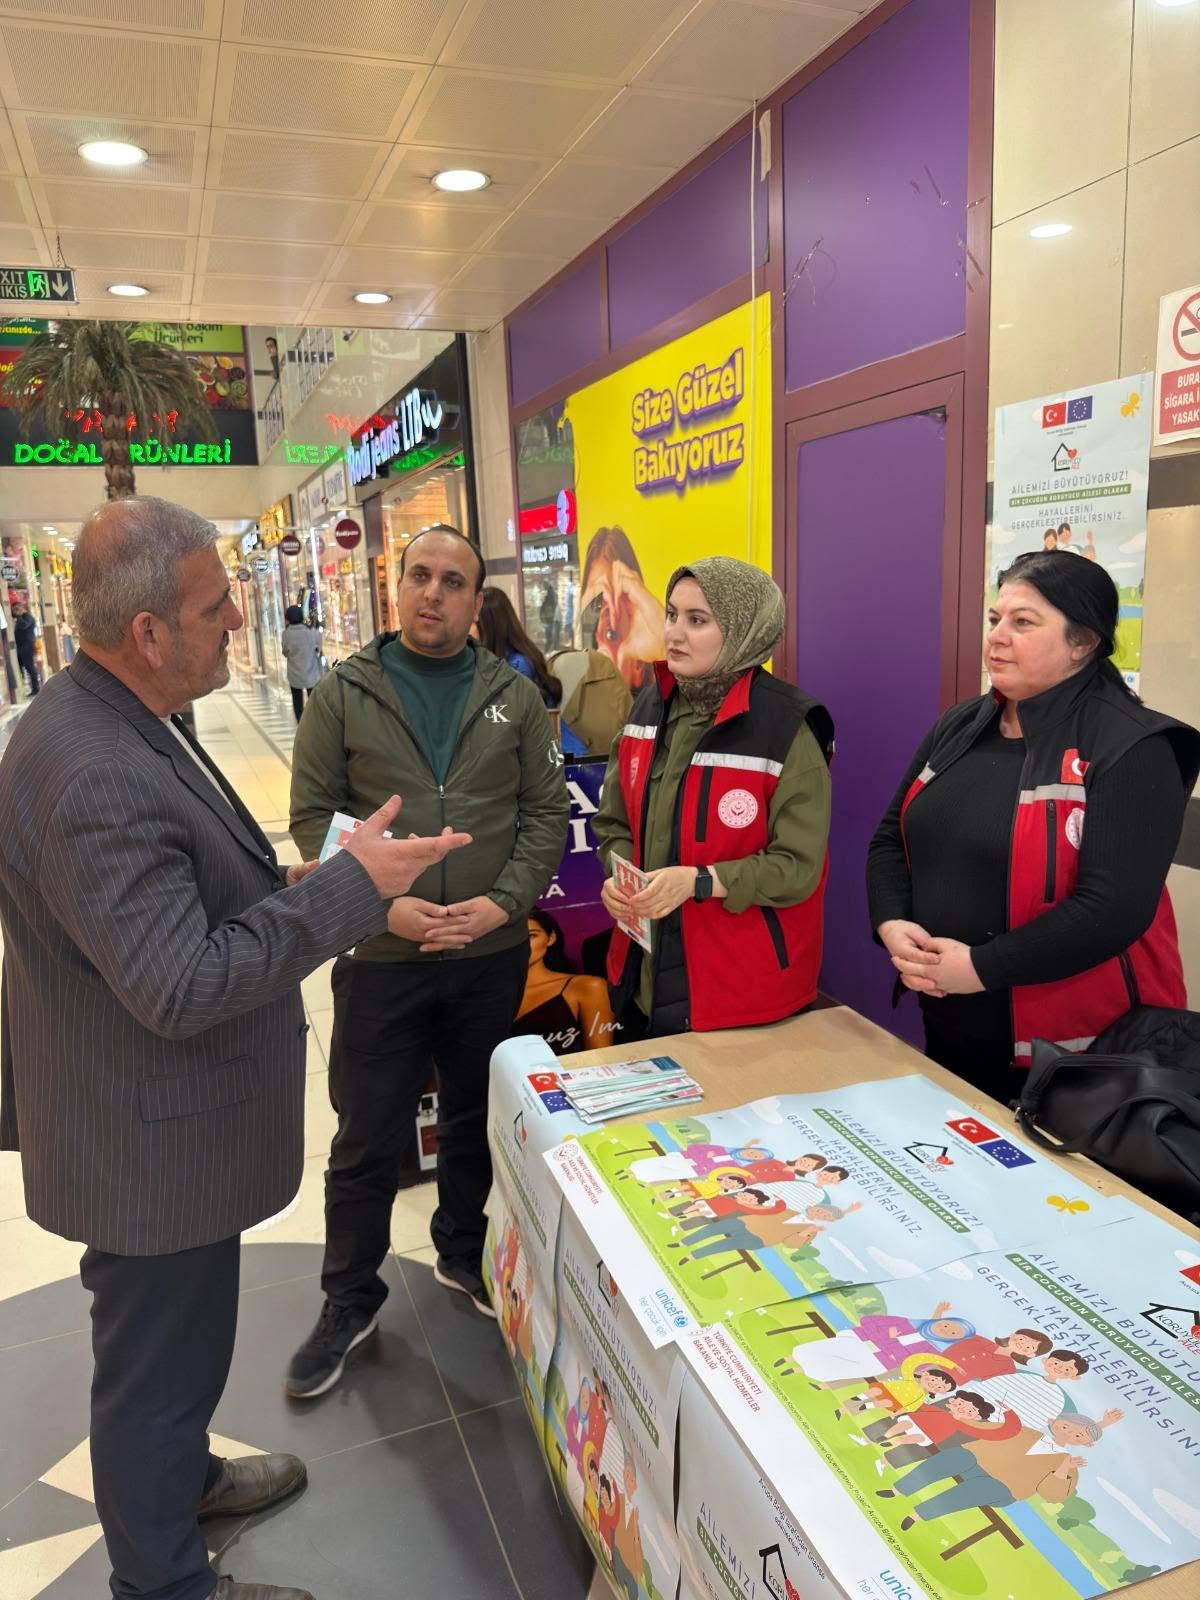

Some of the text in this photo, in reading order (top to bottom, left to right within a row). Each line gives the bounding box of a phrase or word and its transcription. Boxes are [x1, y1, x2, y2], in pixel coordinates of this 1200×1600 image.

[632, 348, 744, 437] Size Güzel
[1164, 391, 1194, 410] SİGARA
[633, 424, 744, 491] Bakıyoruz
[829, 1139, 903, 1197] HAYALLERİNİ
[655, 1288, 683, 1317] unicef
[1012, 1256, 1033, 1272] BİR
[1033, 1273, 1089, 1315] ÇOCUĞUN
[1089, 1317, 1160, 1371] KORUYUCU
[1028, 1252, 1117, 1313] AİLEMİZİ
[1044, 1306, 1171, 1403] HAYALLERİNİ
